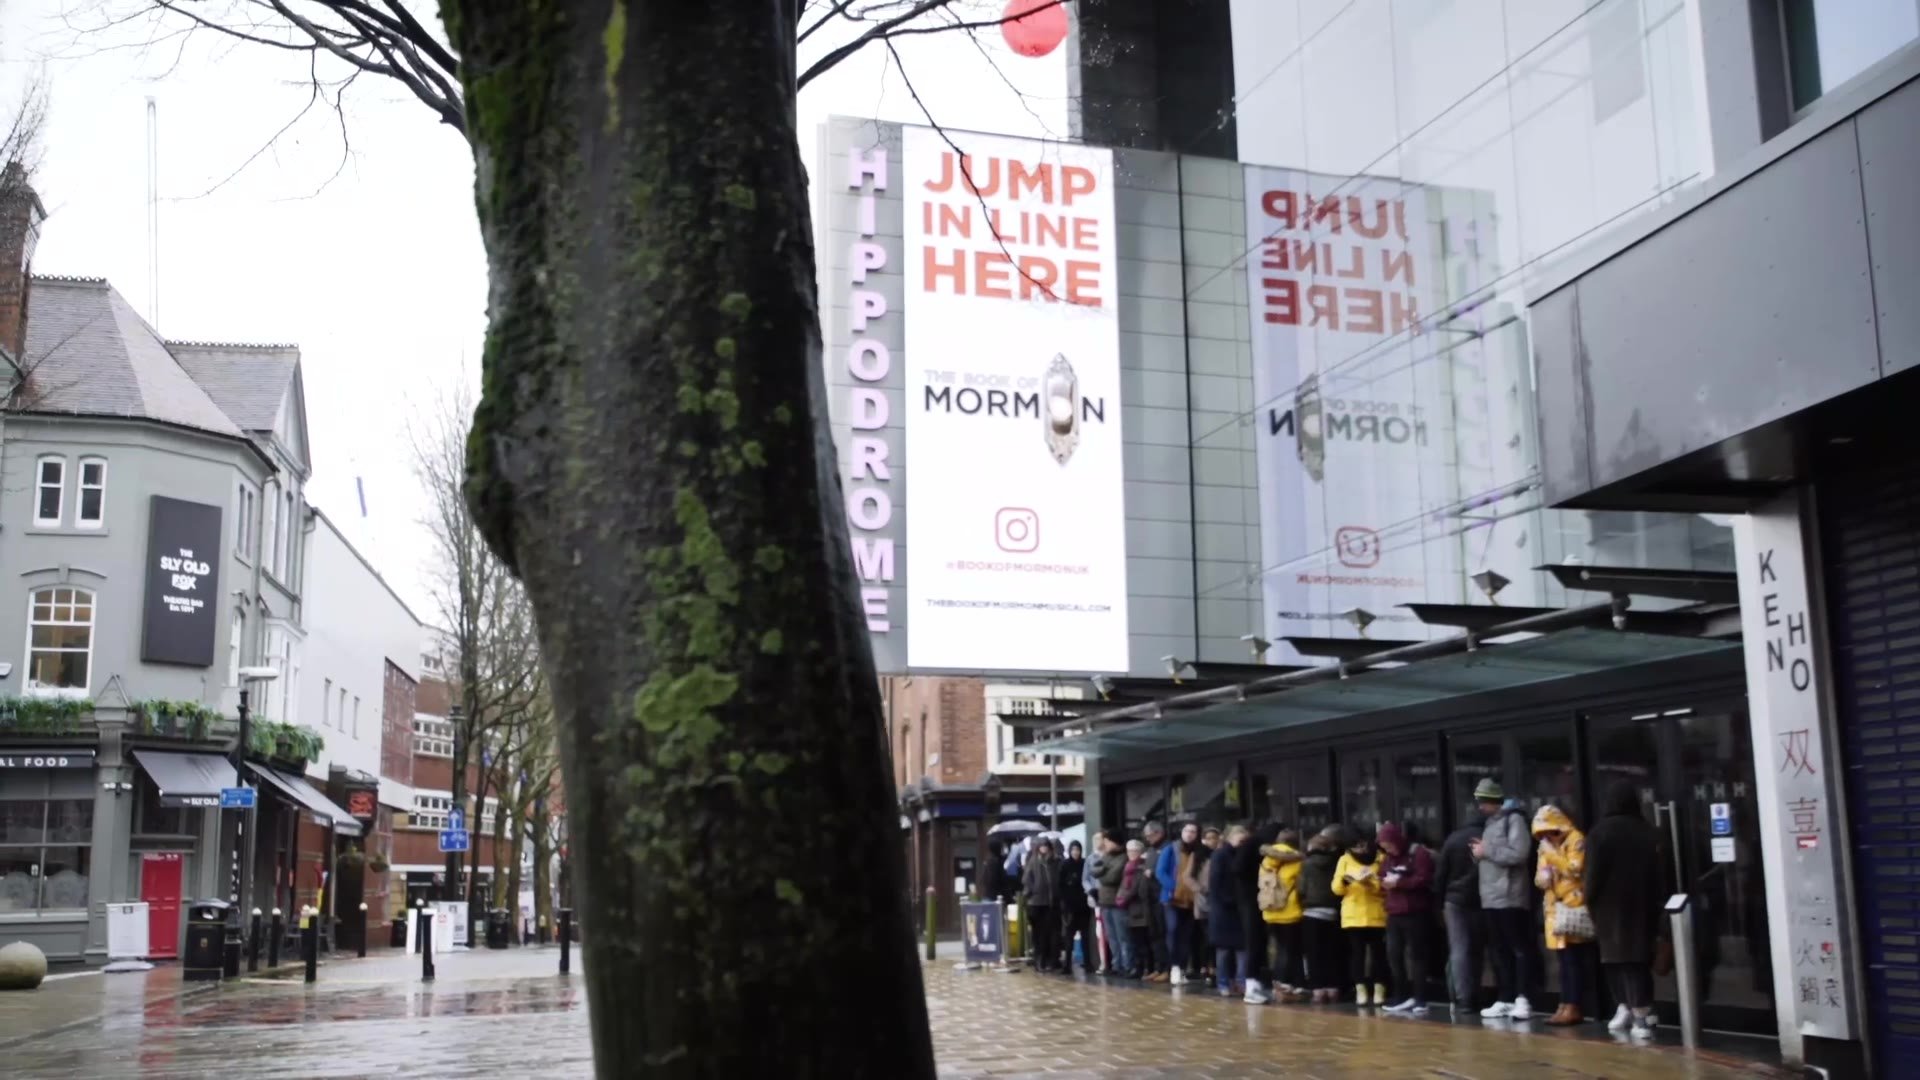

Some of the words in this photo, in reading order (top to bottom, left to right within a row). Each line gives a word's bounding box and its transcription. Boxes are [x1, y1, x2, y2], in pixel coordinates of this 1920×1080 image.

[923, 152, 1096, 206] JUMP
[923, 201, 971, 239] IN
[991, 208, 1099, 251] LINE
[923, 246, 1102, 308] HERE
[849, 149, 894, 632] HIPPODROME
[923, 369, 956, 384] THE
[964, 373, 1011, 387] BOOK
[183, 560, 210, 575] OLD
[1759, 548, 1784, 672] KEN
[24, 757, 69, 767] FOOD
